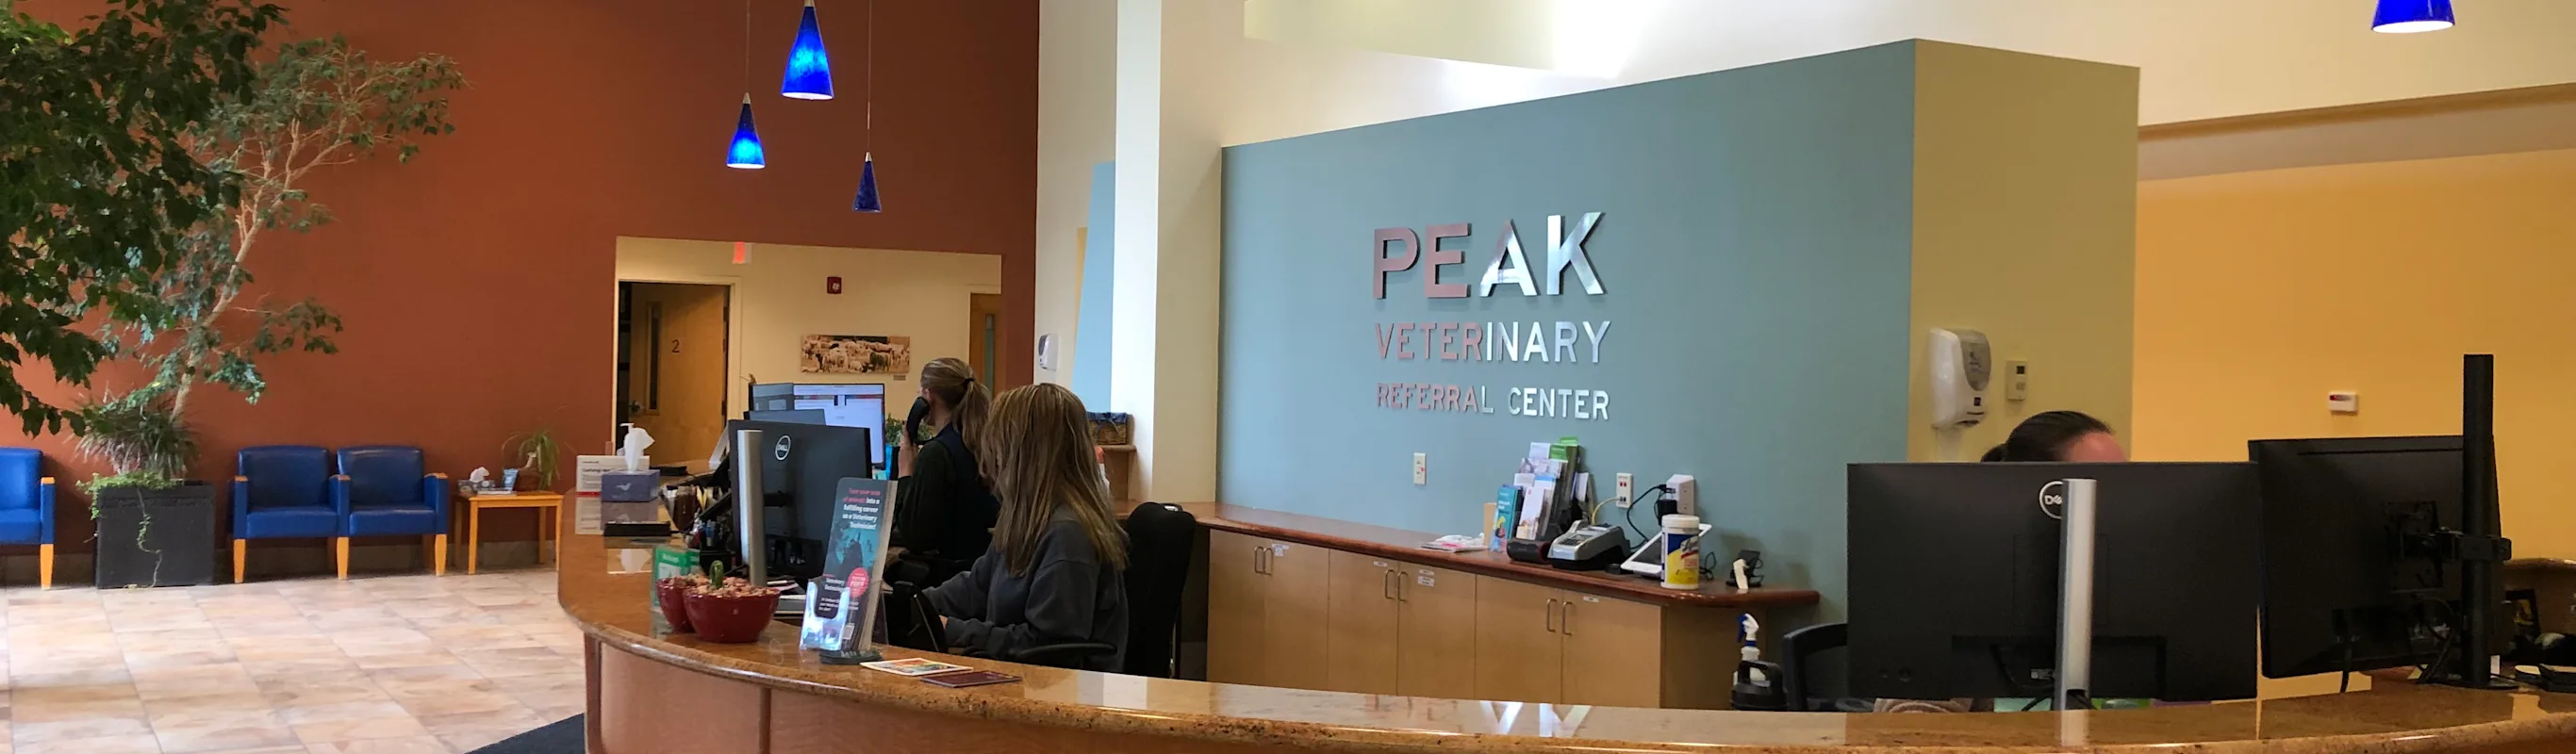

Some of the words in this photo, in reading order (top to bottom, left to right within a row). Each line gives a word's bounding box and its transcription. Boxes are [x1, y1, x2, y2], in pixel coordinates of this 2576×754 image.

[1373, 212, 1606, 300] PEAK
[671, 339, 680, 353] 2
[1375, 320, 1610, 364] VETERINARY
[1377, 382, 1494, 415] REFERRAL
[1509, 386, 1610, 419] CENTER
[2044, 495, 2062, 505] DE
